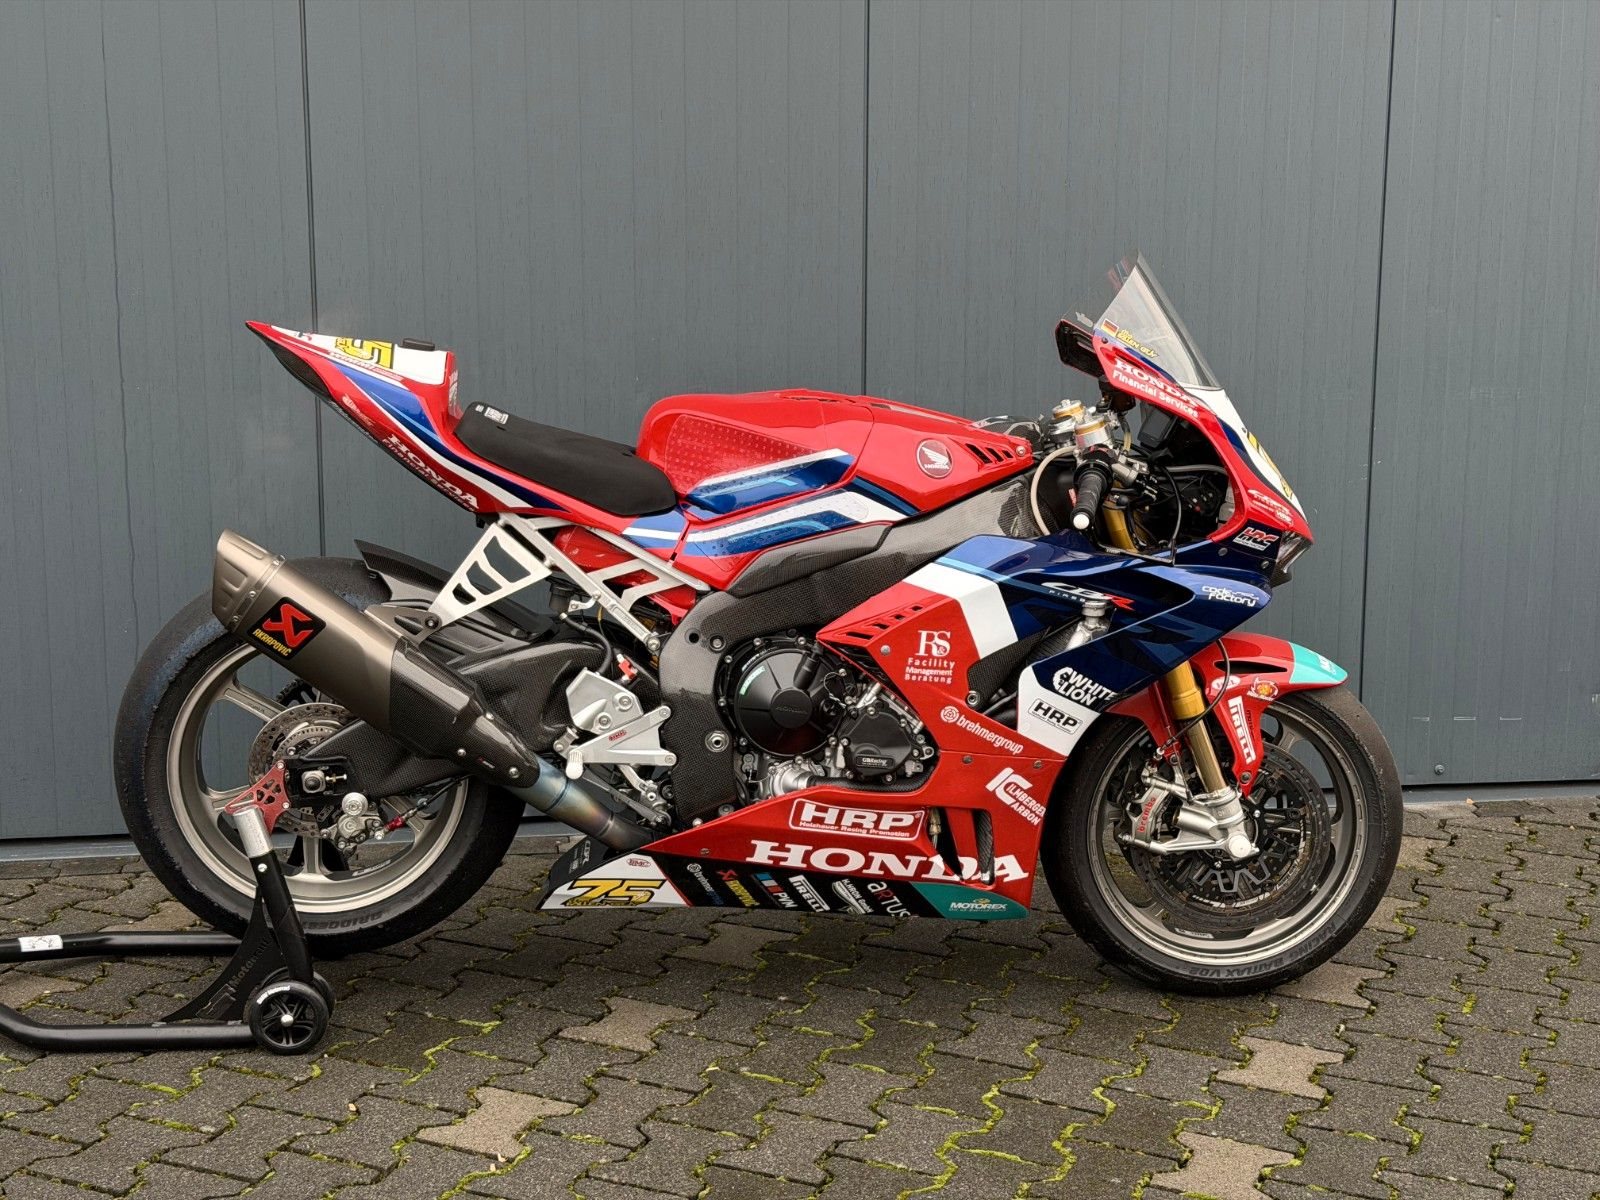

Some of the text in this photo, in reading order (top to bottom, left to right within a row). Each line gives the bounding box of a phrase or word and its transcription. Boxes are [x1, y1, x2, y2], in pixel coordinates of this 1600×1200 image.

[1112, 371, 1199, 419] Financial Services
[1114, 357, 1199, 408] HONDA
[387, 433, 479, 509] HONDA
[905, 666, 953, 677] Management
[907, 656, 956, 669] Facility
[904, 673, 953, 685] Beratung
[1058, 681, 1098, 707] LION
[1068, 669, 1120, 701] WHITE
[1033, 699, 1079, 729] HRP
[956, 714, 1024, 755] brehmergroup
[1227, 695, 1257, 765] PIRELLI
[800, 802, 915, 831] HRP
[1137, 797, 1157, 833] brembo
[840, 825, 867, 835] Racing
[869, 828, 910, 838] Promotion
[745, 839, 1029, 884] HONDA
[561, 878, 667, 907] 75
[788, 874, 831, 913] PIRELLI
[950, 902, 1008, 911] MOTOREX
